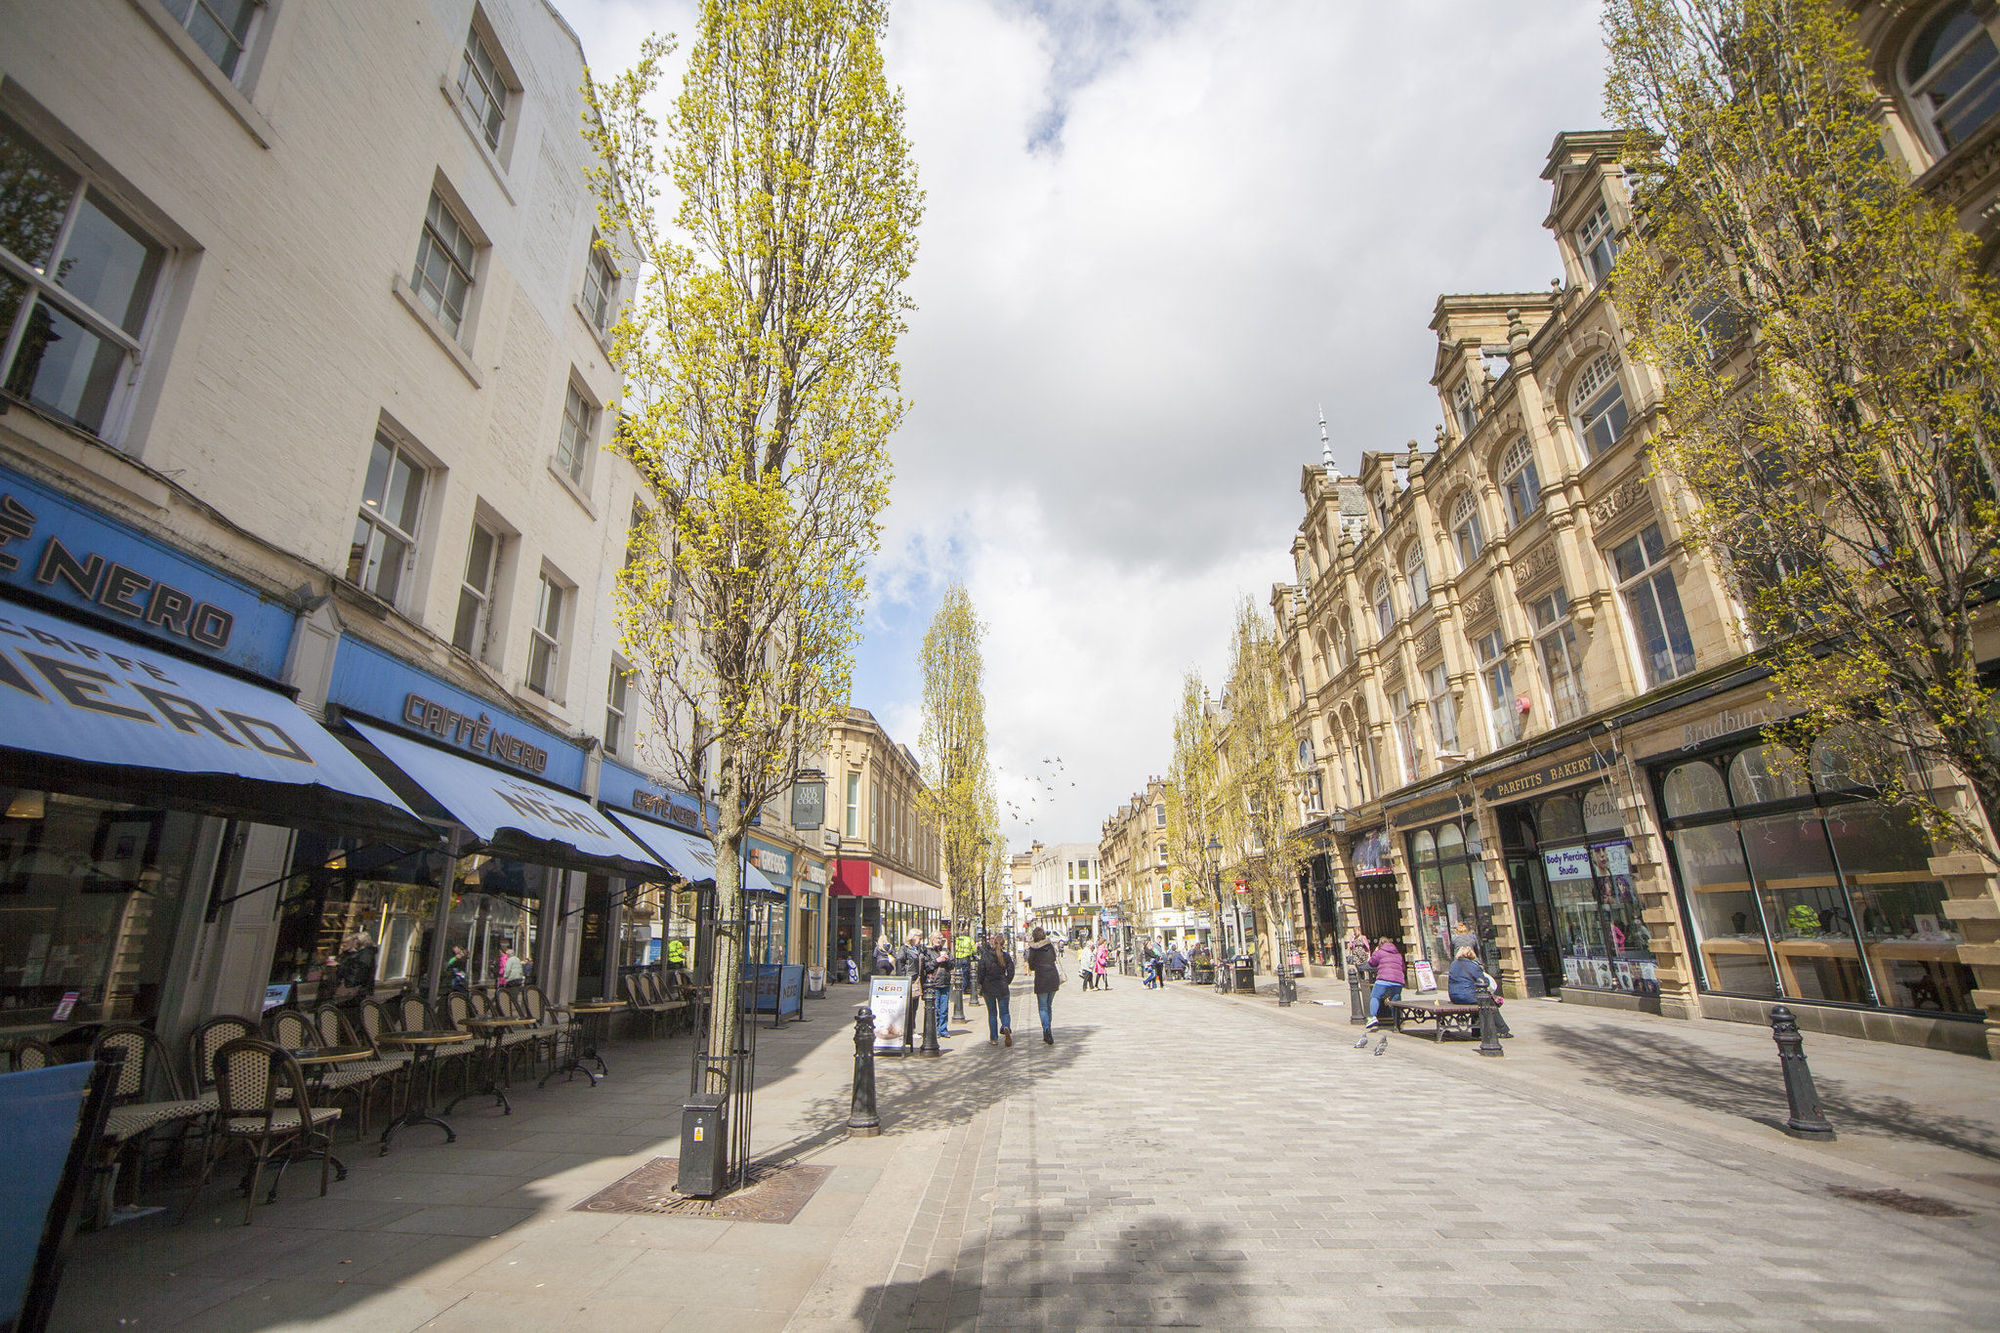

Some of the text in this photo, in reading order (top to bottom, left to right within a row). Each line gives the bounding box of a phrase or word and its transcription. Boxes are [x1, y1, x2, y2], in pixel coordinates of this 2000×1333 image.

[37, 536, 234, 650] NERO
[403, 693, 548, 773] CAFFÈ NERO
[1497, 756, 1592, 796] PARFITTS BAKERY
[488, 785, 612, 840] NERO
[1546, 851, 1589, 866] Body Piercing
[1558, 864, 1579, 875] Studio
